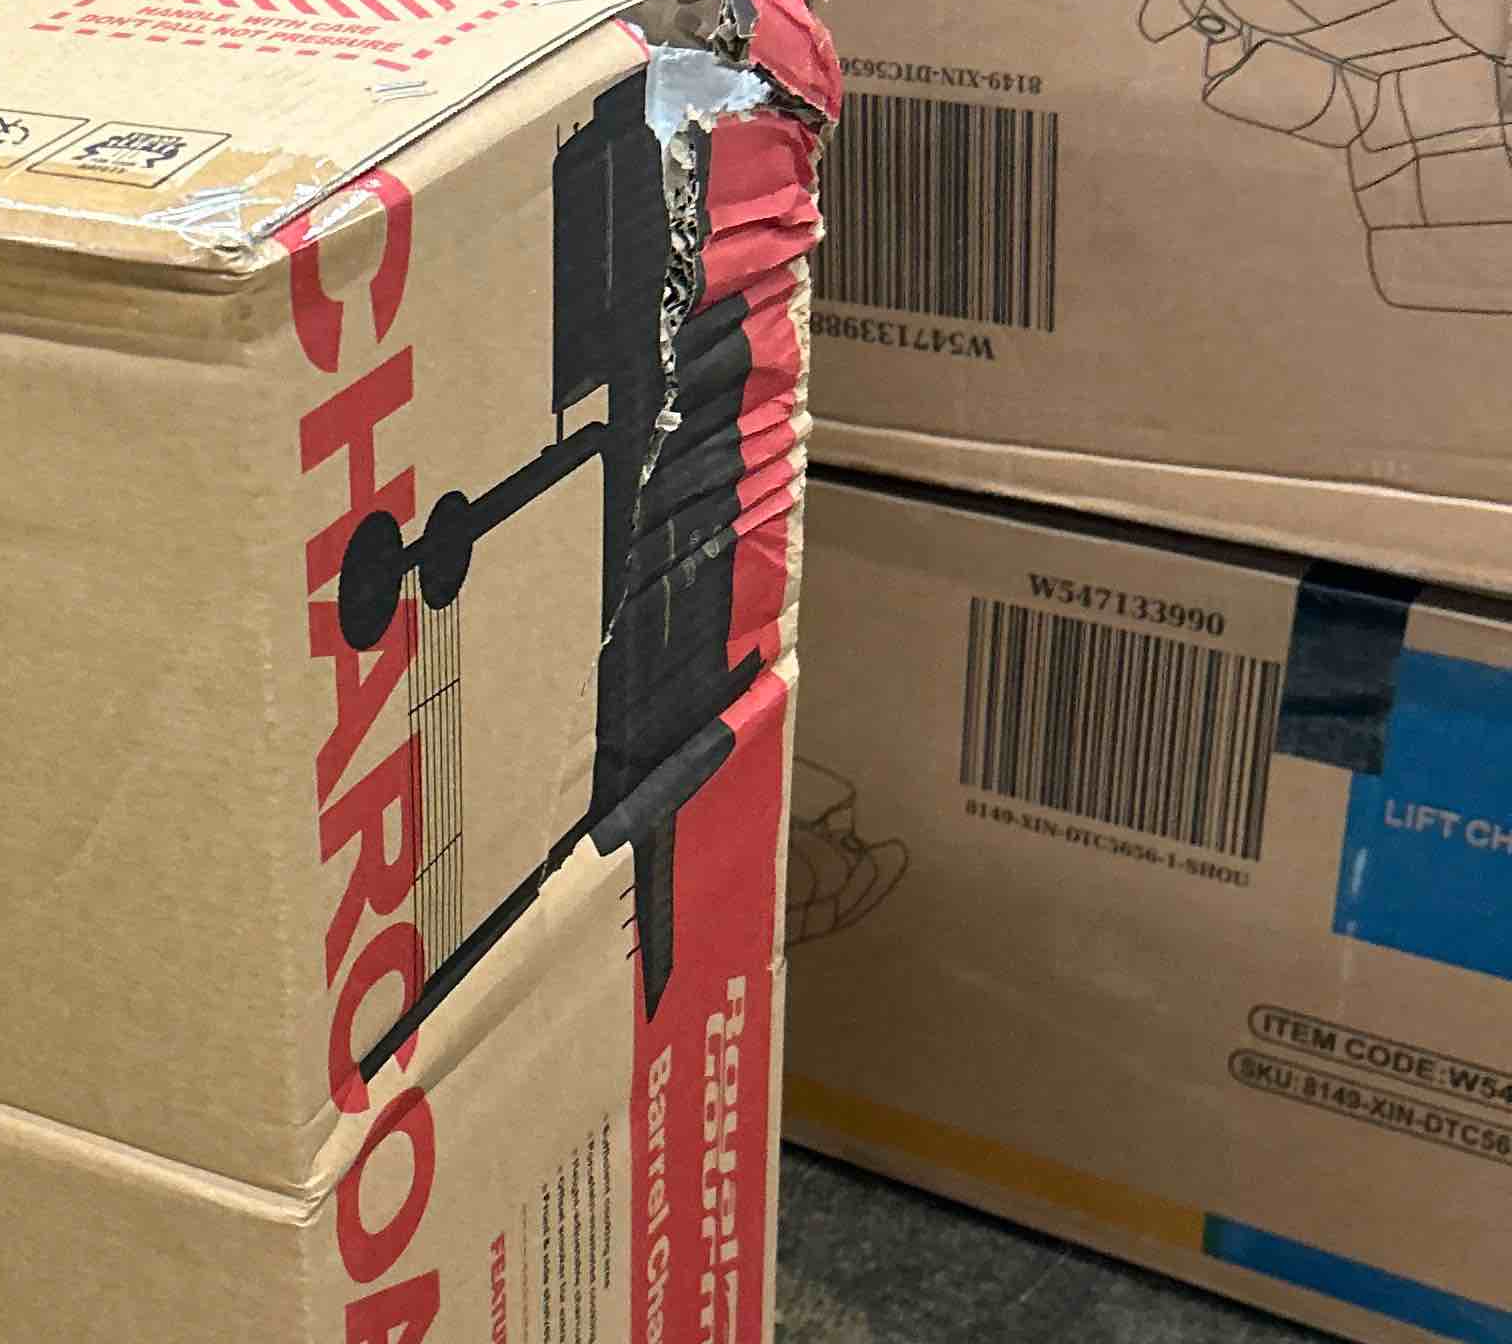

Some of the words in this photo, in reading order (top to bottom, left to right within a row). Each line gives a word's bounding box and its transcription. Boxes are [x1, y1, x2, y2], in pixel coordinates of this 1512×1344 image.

[136, 6, 235, 23] HANDLE
[242, 16, 309, 30] WITH
[310, 23, 381, 36] CARE
[149, 20, 207, 35] FALL
[211, 27, 269, 39] NOT
[264, 30, 403, 53] PRESSURE
[1028, 573, 1226, 637] W547133990
[1384, 799, 1462, 840] LIFT
[1464, 819, 1512, 855] CH
[1262, 1012, 1337, 1054] ITEM
[647, 1044, 673, 1235] Barrel
[719, 976, 747, 1262] Royal
